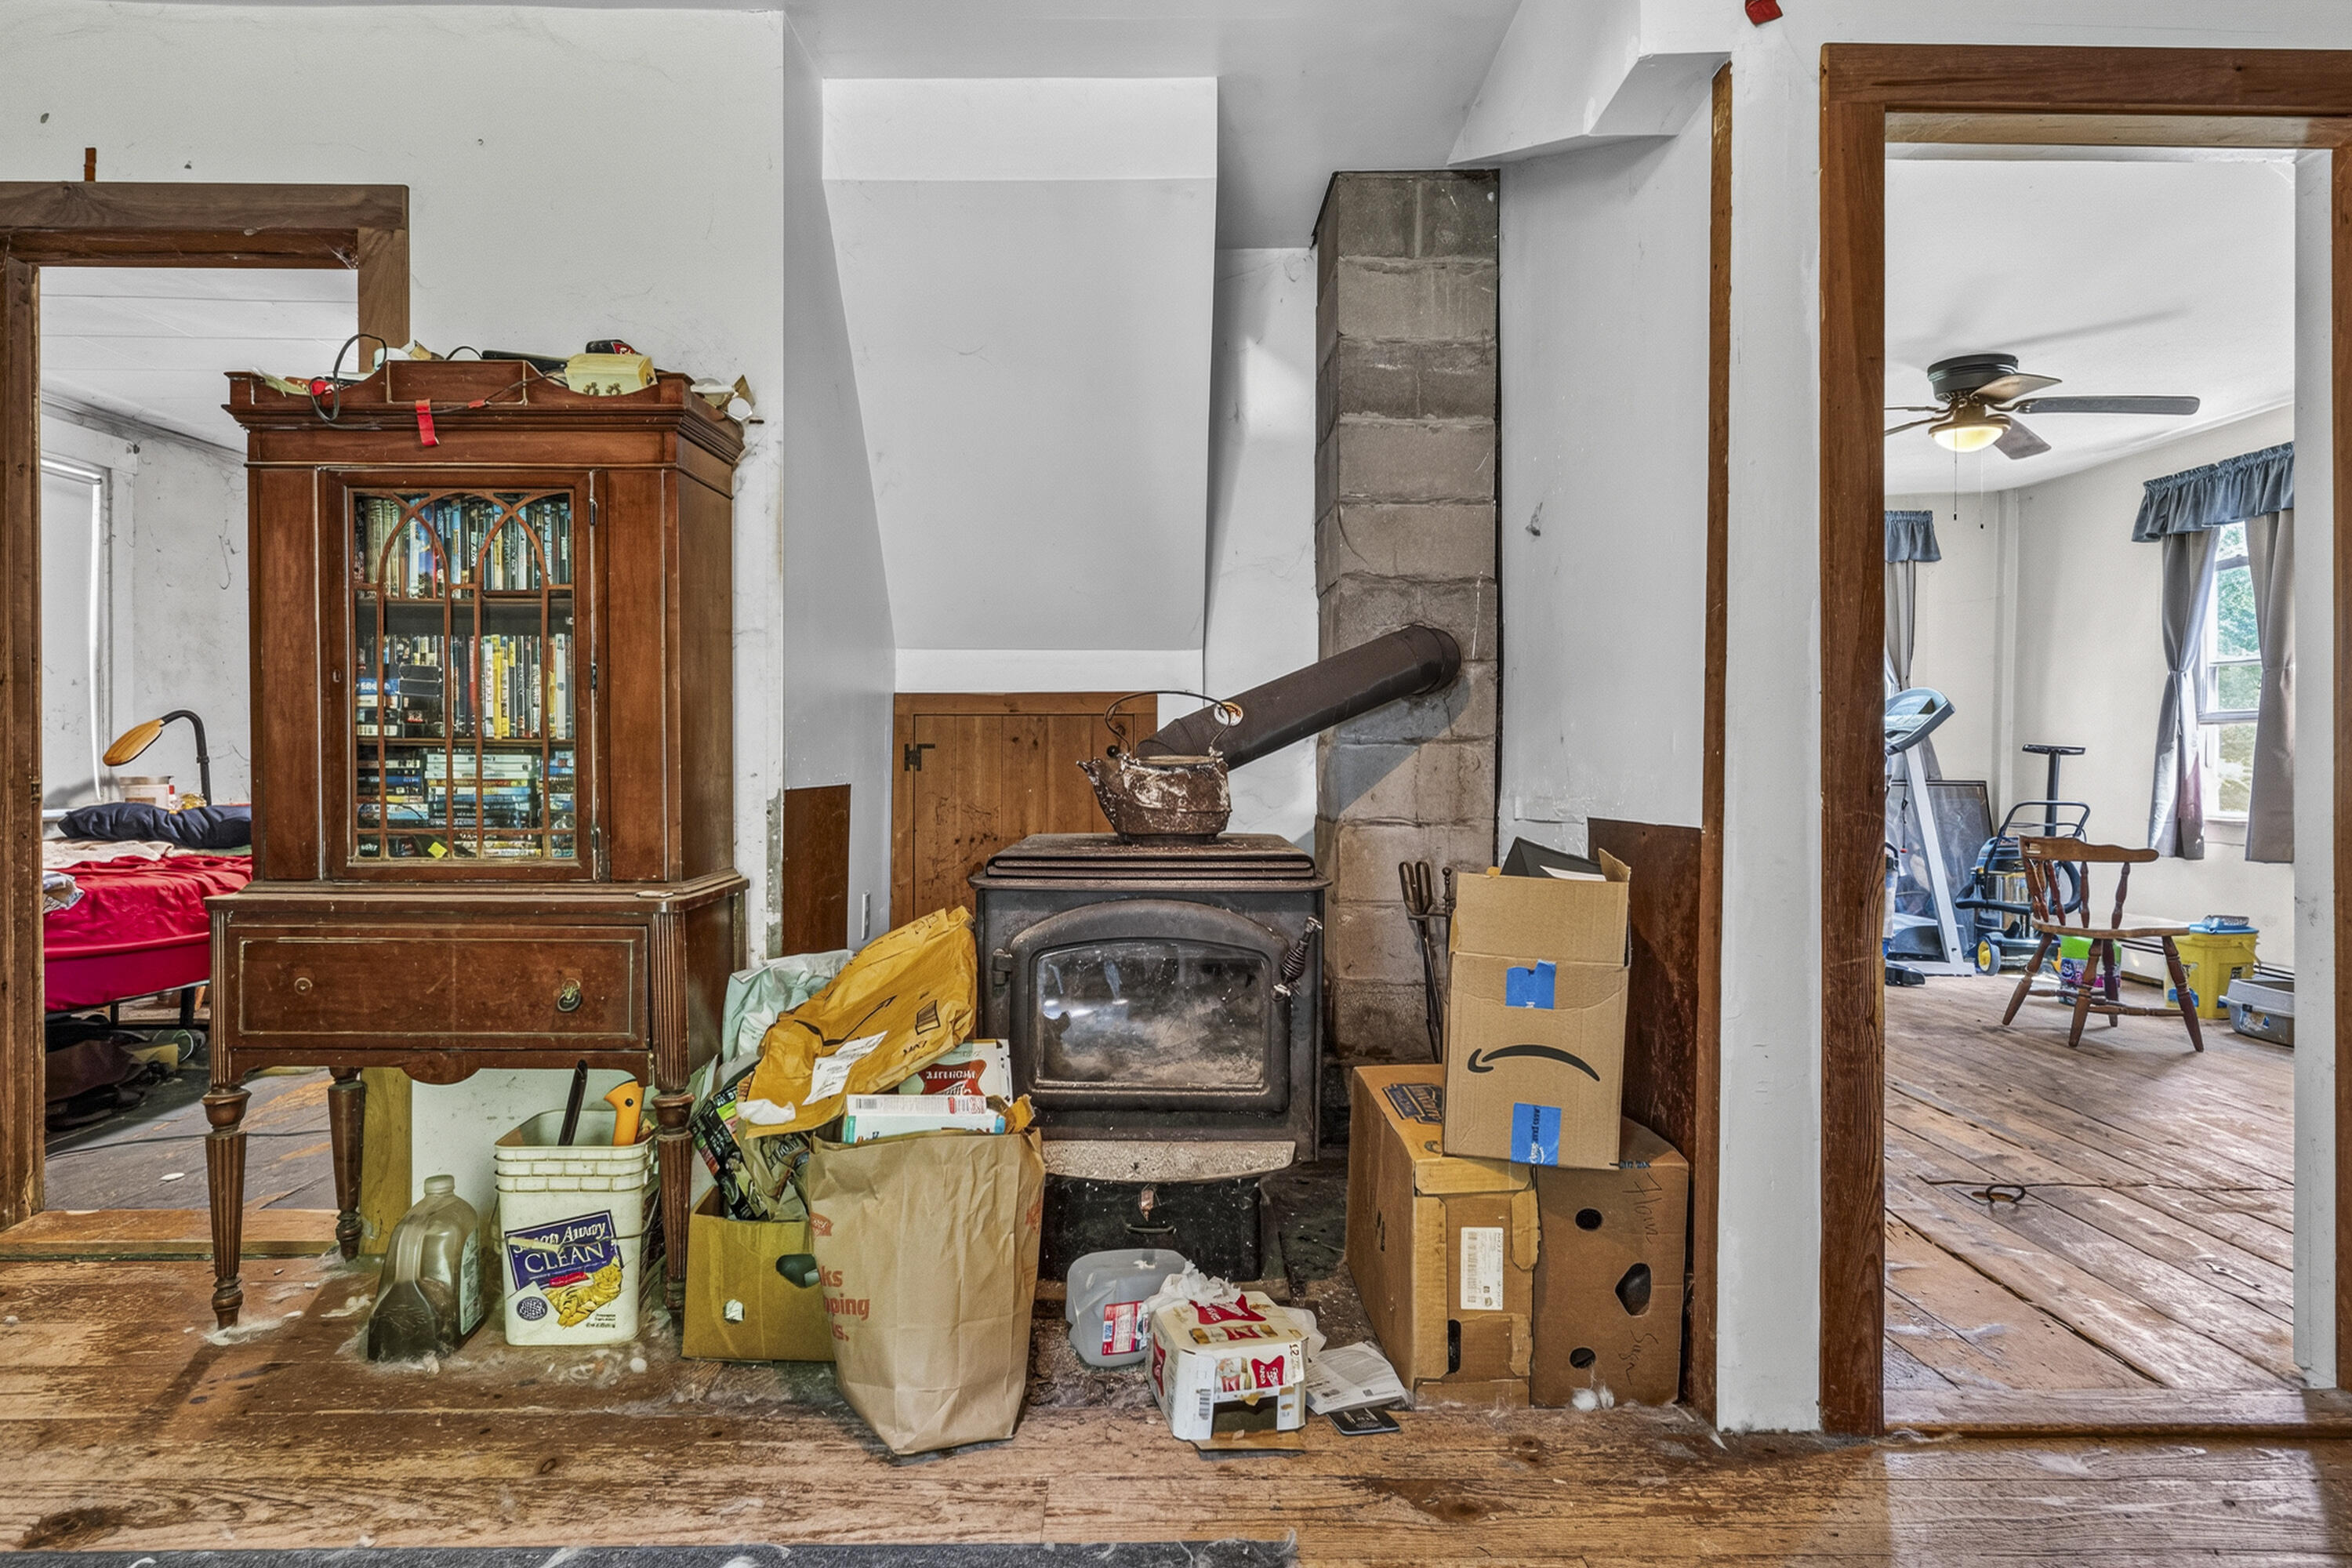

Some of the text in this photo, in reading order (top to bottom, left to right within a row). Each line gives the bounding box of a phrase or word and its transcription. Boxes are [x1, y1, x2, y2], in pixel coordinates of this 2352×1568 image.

[561, 1221, 607, 1244] Away
[524, 1241, 605, 1274] CLEAN
[819, 1265, 844, 1288] ks
